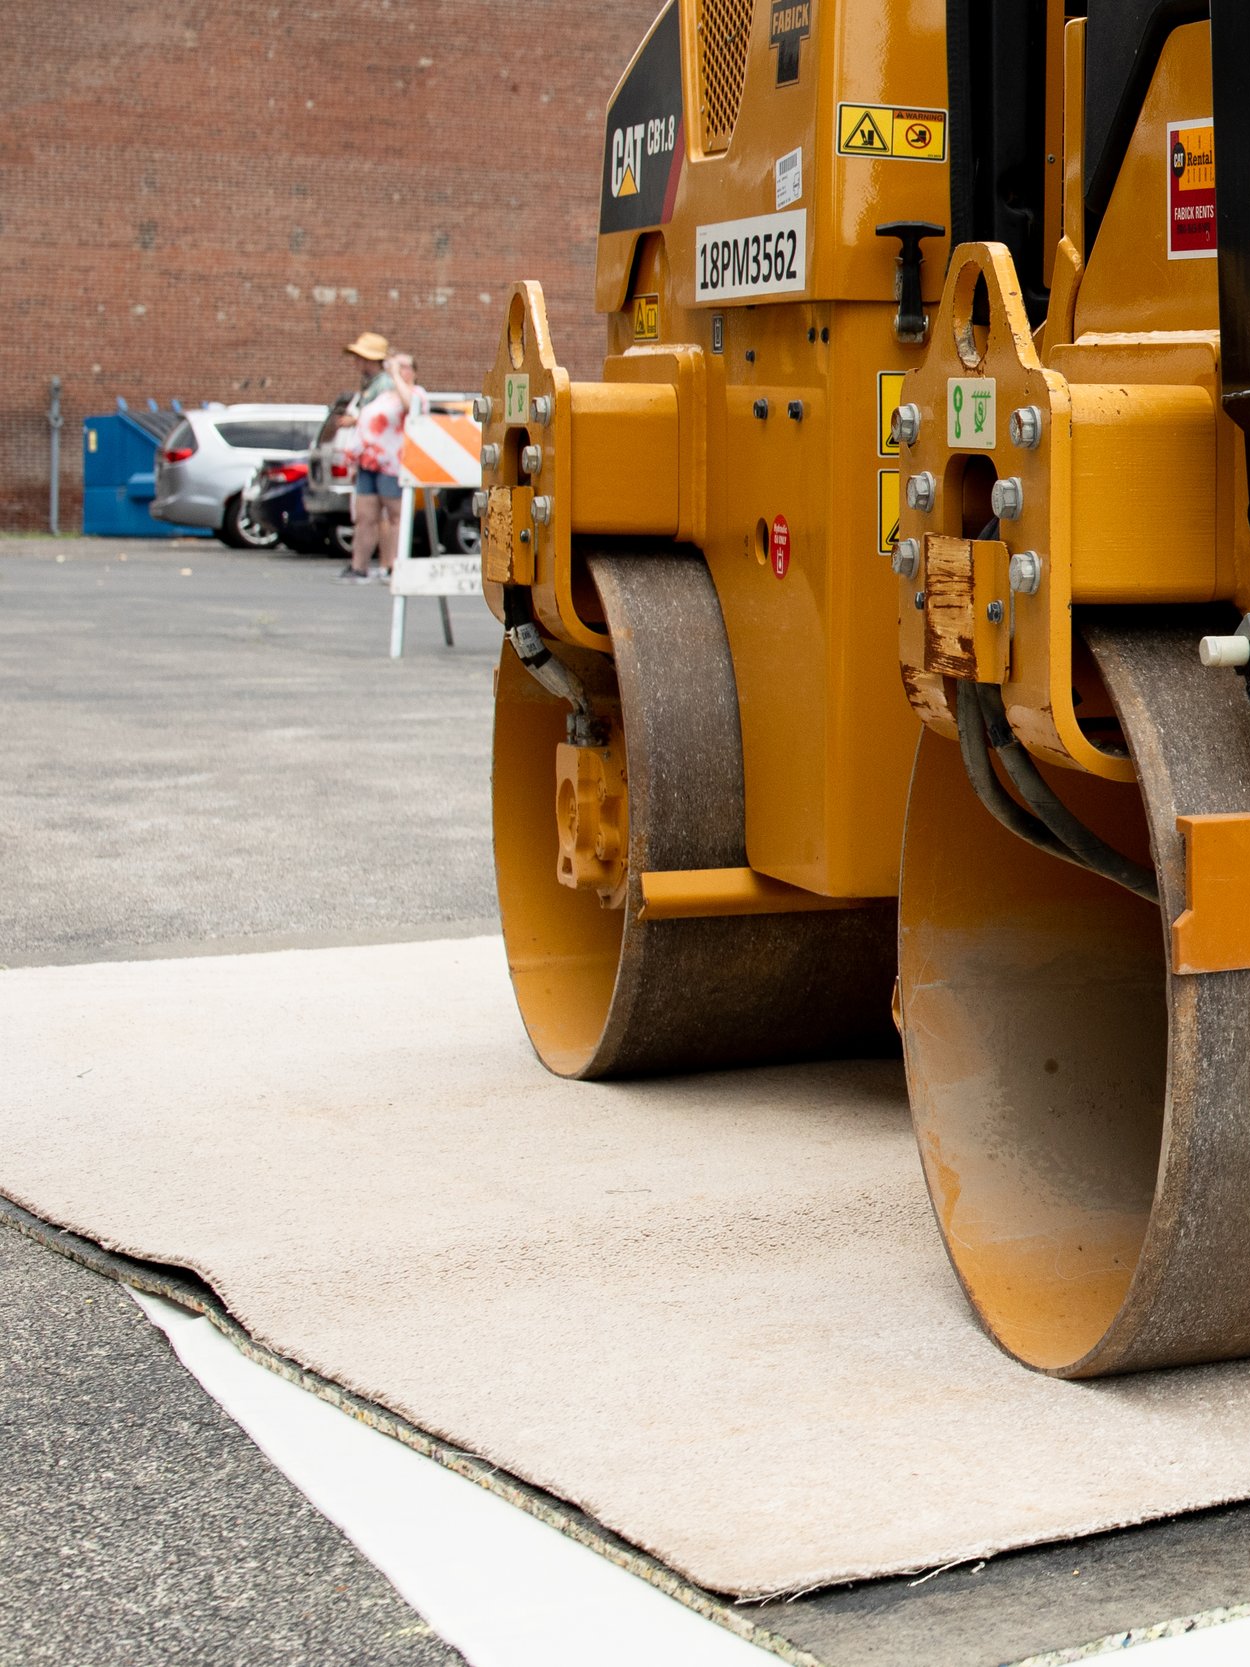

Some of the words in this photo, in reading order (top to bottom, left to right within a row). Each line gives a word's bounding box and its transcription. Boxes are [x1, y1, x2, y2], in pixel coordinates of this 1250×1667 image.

[773, 3, 809, 35] FABICK
[905, 112, 943, 121] WARNING
[611, 123, 645, 198] CAT
[647, 114, 675, 156] CB1.8
[1173, 153, 1184, 168] CAT
[1186, 150, 1213, 167] Rental
[1174, 206, 1195, 221] FABICK
[1195, 205, 1215, 219] RENTS
[700, 229, 797, 290] 18PM3562
